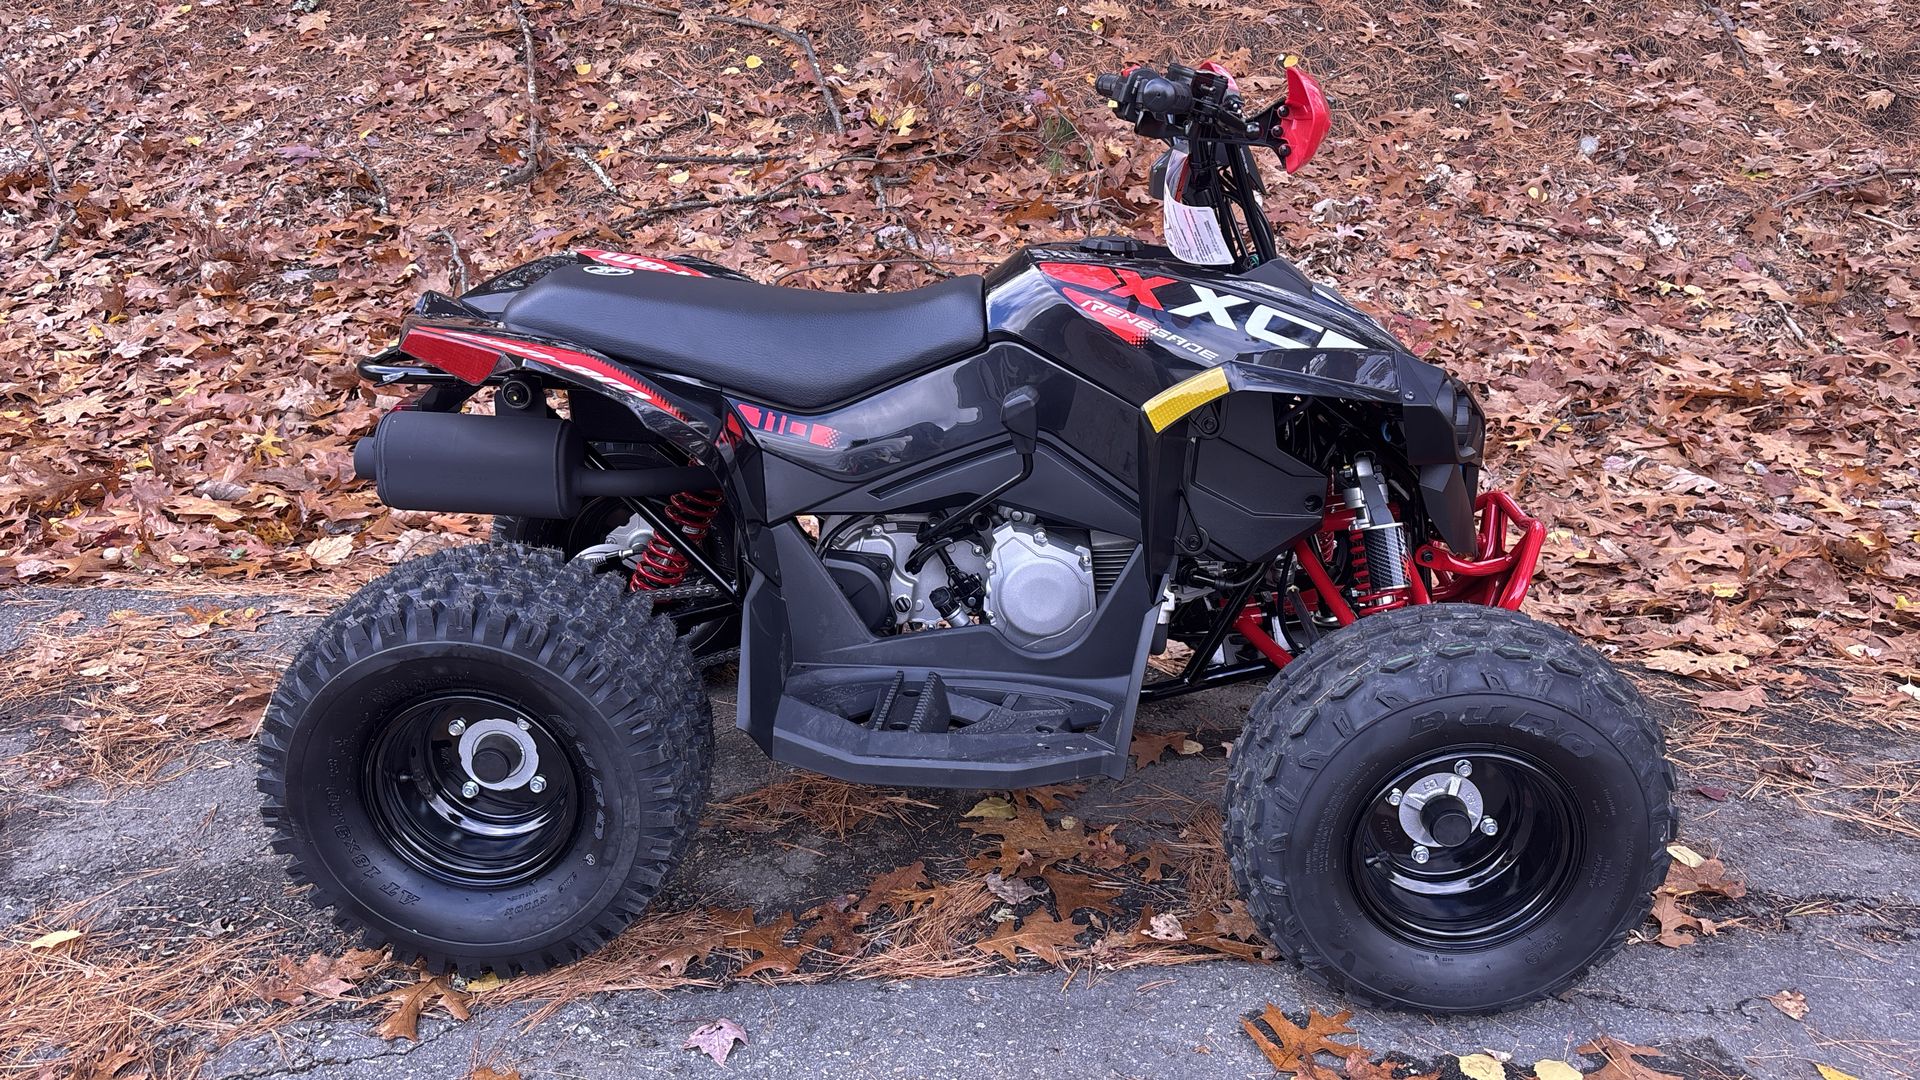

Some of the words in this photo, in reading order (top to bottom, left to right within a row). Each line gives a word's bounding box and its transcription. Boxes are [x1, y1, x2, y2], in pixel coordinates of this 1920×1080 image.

[1080, 299, 1220, 361] RENEGADE
[1408, 704, 1596, 759] DURO
[379, 881, 421, 905] AT
